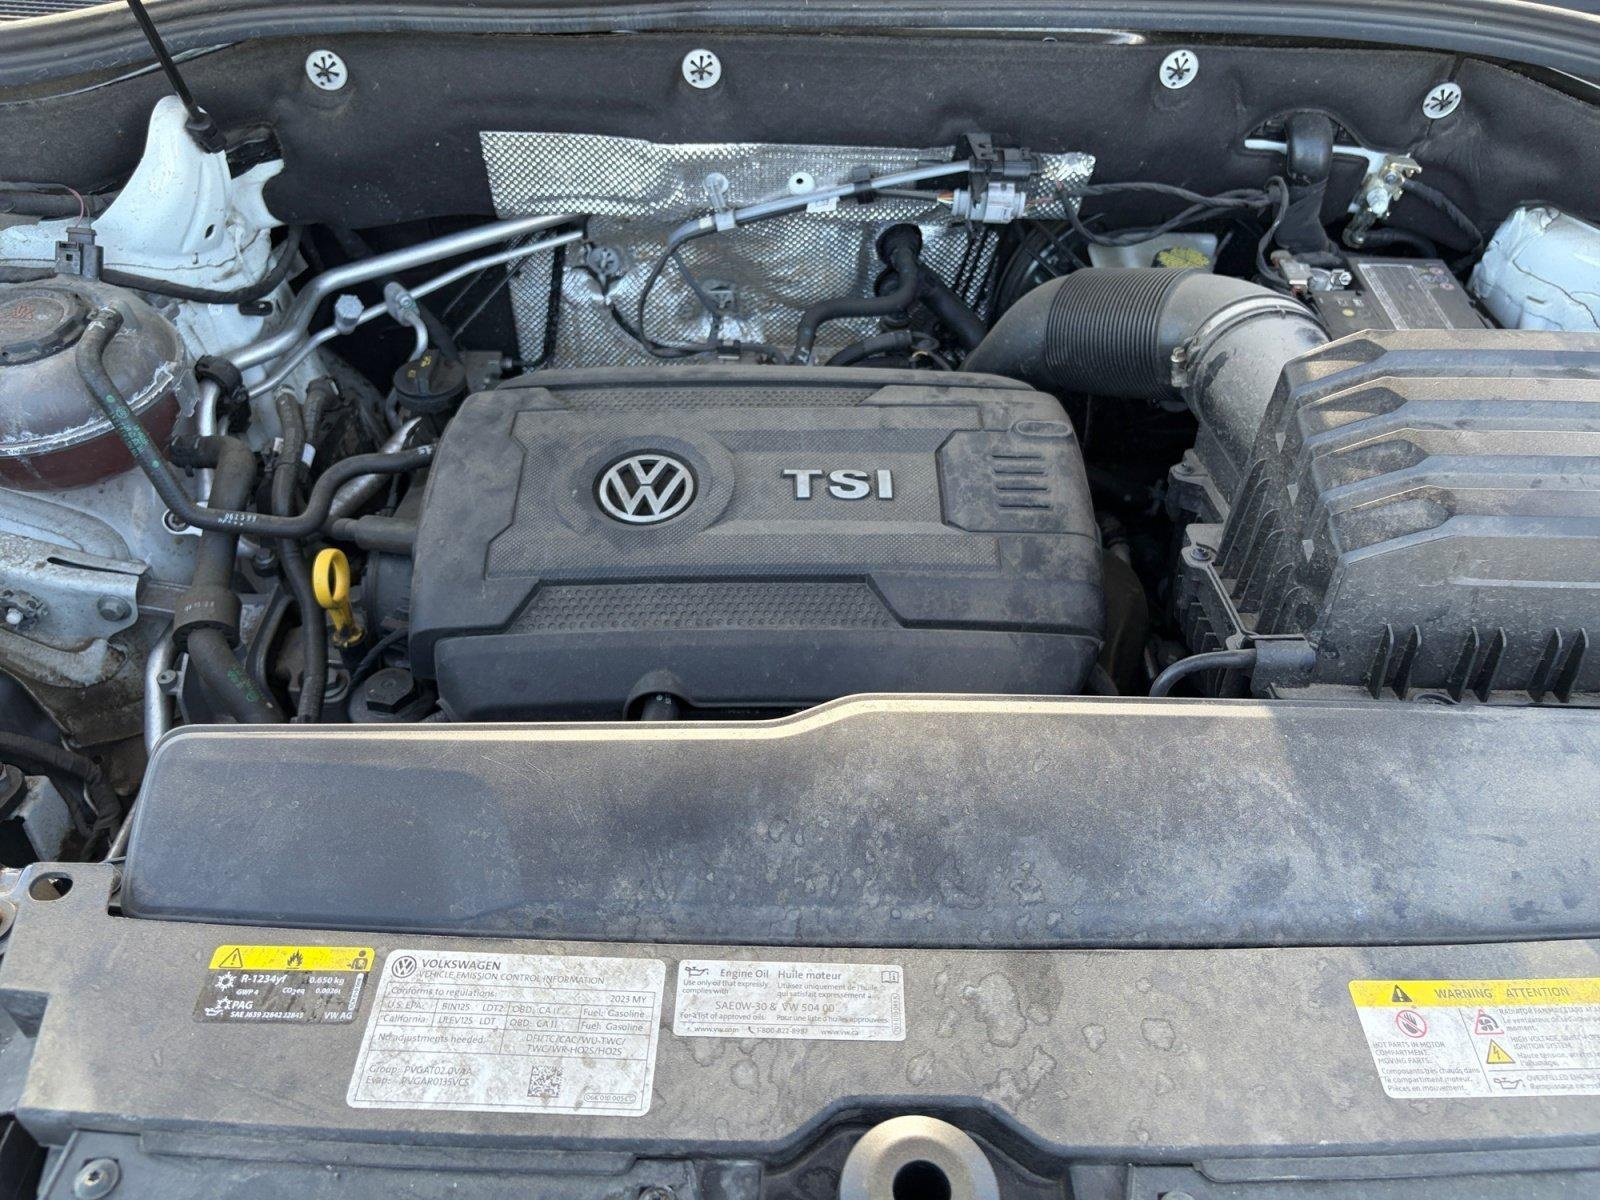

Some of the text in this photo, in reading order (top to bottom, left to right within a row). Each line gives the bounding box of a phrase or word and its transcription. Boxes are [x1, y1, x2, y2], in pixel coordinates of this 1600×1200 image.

[782, 468, 894, 500] TSI
[421, 959, 502, 970] VOLKSWAGEN
[420, 971, 605, 985] VEHICLE EMISSION CONTROL INFORMATION
[720, 968, 769, 980] Engine Oil
[778, 970, 842, 980] Huile moteur
[240, 974, 345, 986] R-1234yf 0.650 kg
[738, 980, 768, 988] expressly
[236, 988, 253, 996] GWP
[391, 986, 497, 998] Conforms to regulations:
[1434, 987, 1569, 999] WARNING ATTENTION
[610, 995, 647, 1003] 2023 MY
[232, 1001, 254, 1009] PAG
[442, 1003, 470, 1011] BIN125
[482, 1004, 504, 1012] LDT2
[538, 1006, 552, 1014] CA
[607, 1010, 645, 1018] Gasoline
[715, 1001, 834, 1012] SAE0W-30 & VW 504 00
[719, 1013, 752, 1021] approved
[439, 1016, 473, 1024] ULEV125
[479, 1017, 497, 1025] LDT
[536, 1020, 549, 1028] CA
[605, 1023, 644, 1032] Gasoline
[378, 1033, 393, 1041] No
[394, 1034, 448, 1044] adjustments
[1392, 1076, 1443, 1084] compartiment
